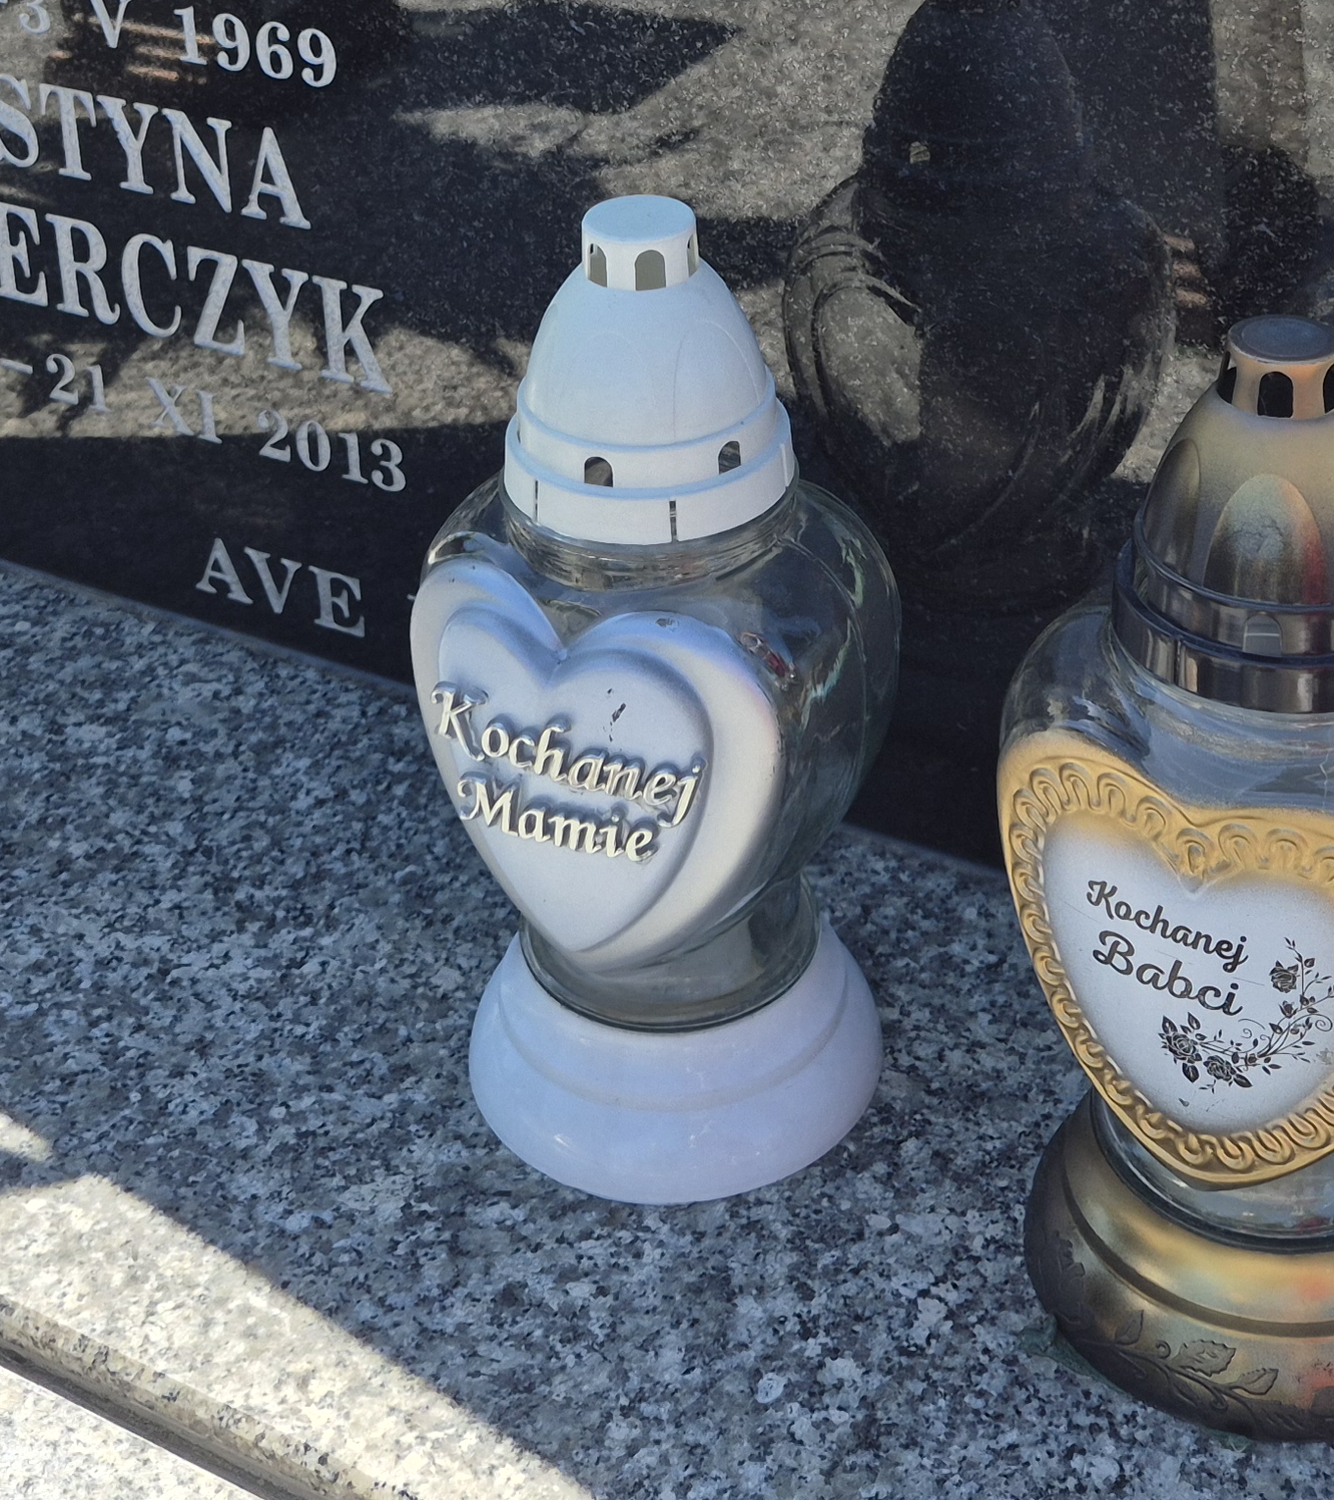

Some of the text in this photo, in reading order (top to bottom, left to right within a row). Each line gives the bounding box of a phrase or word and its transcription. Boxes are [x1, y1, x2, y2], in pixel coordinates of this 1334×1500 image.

[175, 6, 337, 88] 1969
[145, 377, 222, 444] XI
[258, 410, 406, 492] 2013
[196, 538, 365, 638] AVE
[431, 681, 708, 828] Kochanej
[457, 771, 659, 862] Mamie
[1085, 880, 1248, 973] Kochanej
[1092, 930, 1243, 1016] Babci
